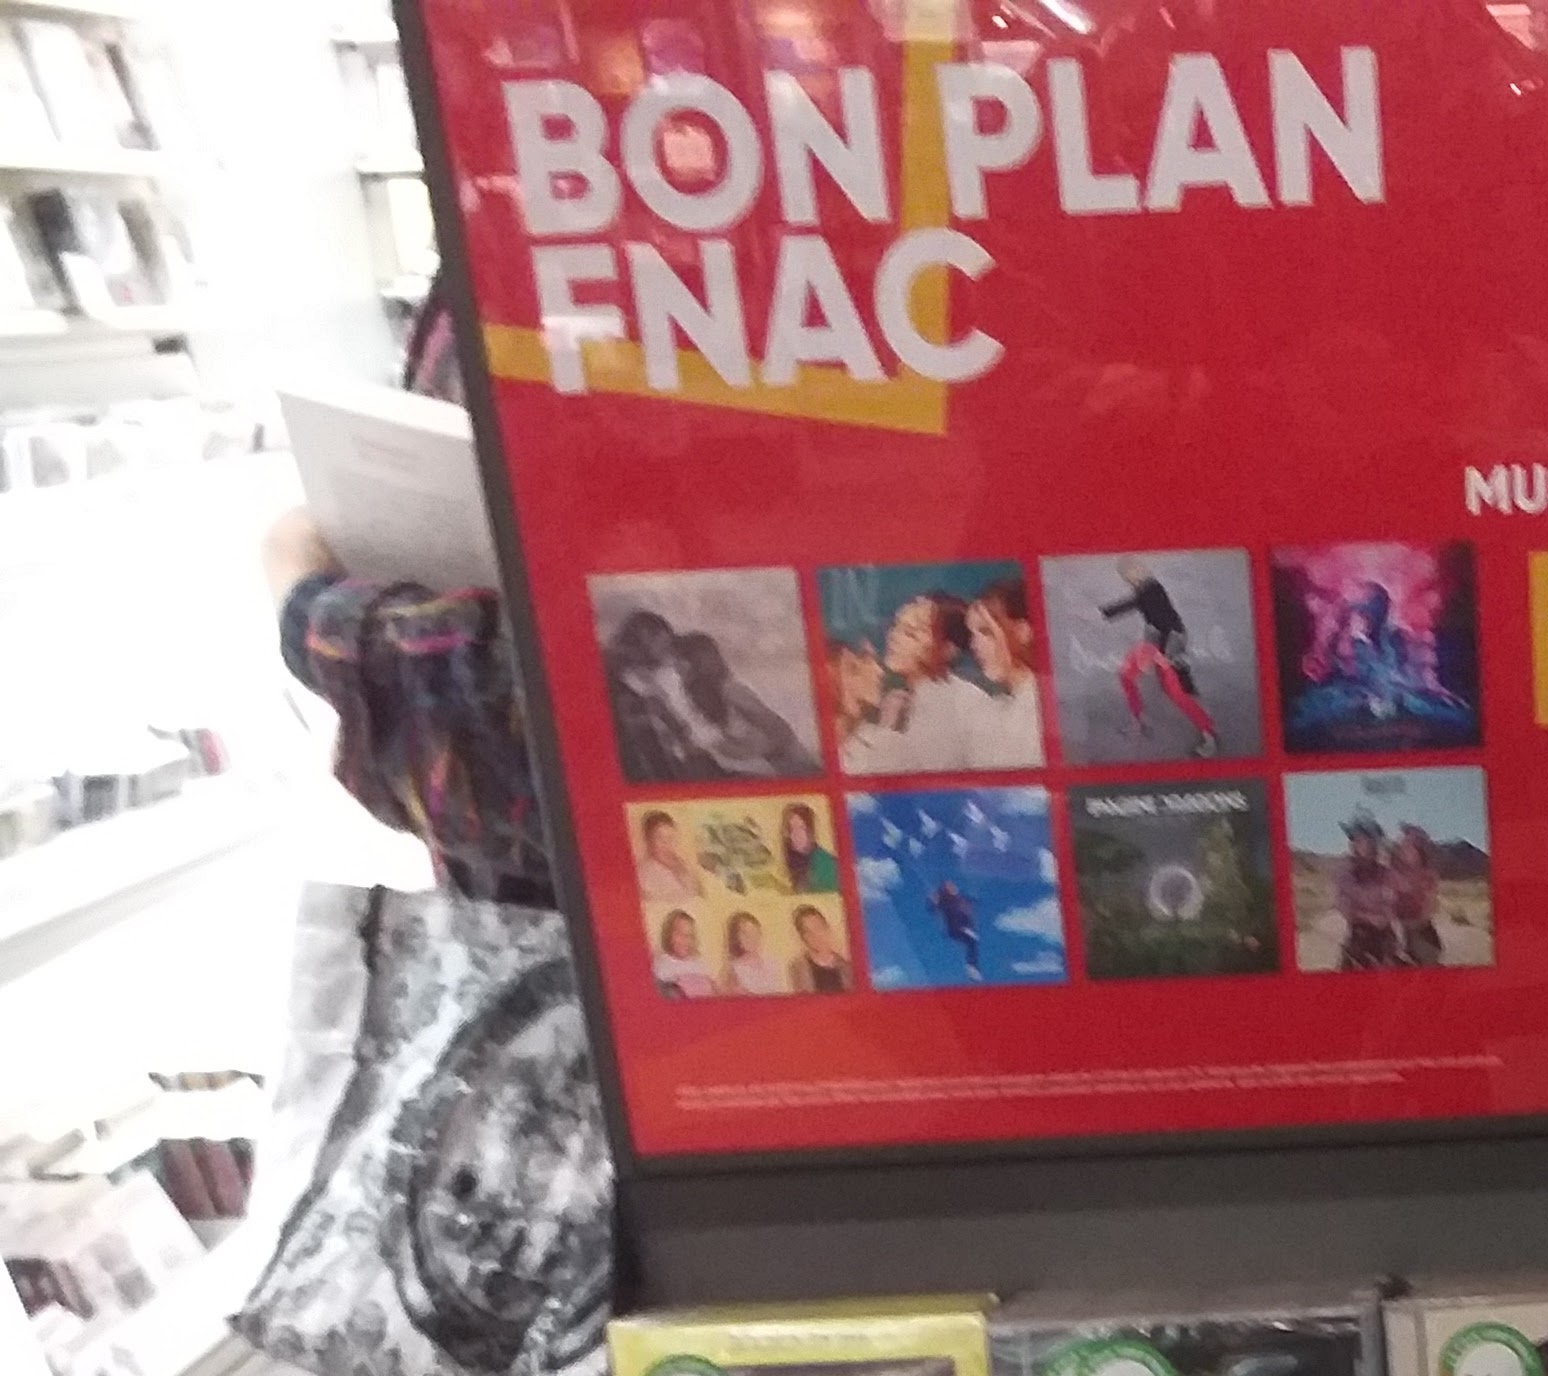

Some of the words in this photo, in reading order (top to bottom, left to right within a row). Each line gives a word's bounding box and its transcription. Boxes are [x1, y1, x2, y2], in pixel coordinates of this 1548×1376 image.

[501, 68, 892, 236] BON
[937, 45, 1386, 222] PLAN
[531, 226, 1006, 396] FNAC
